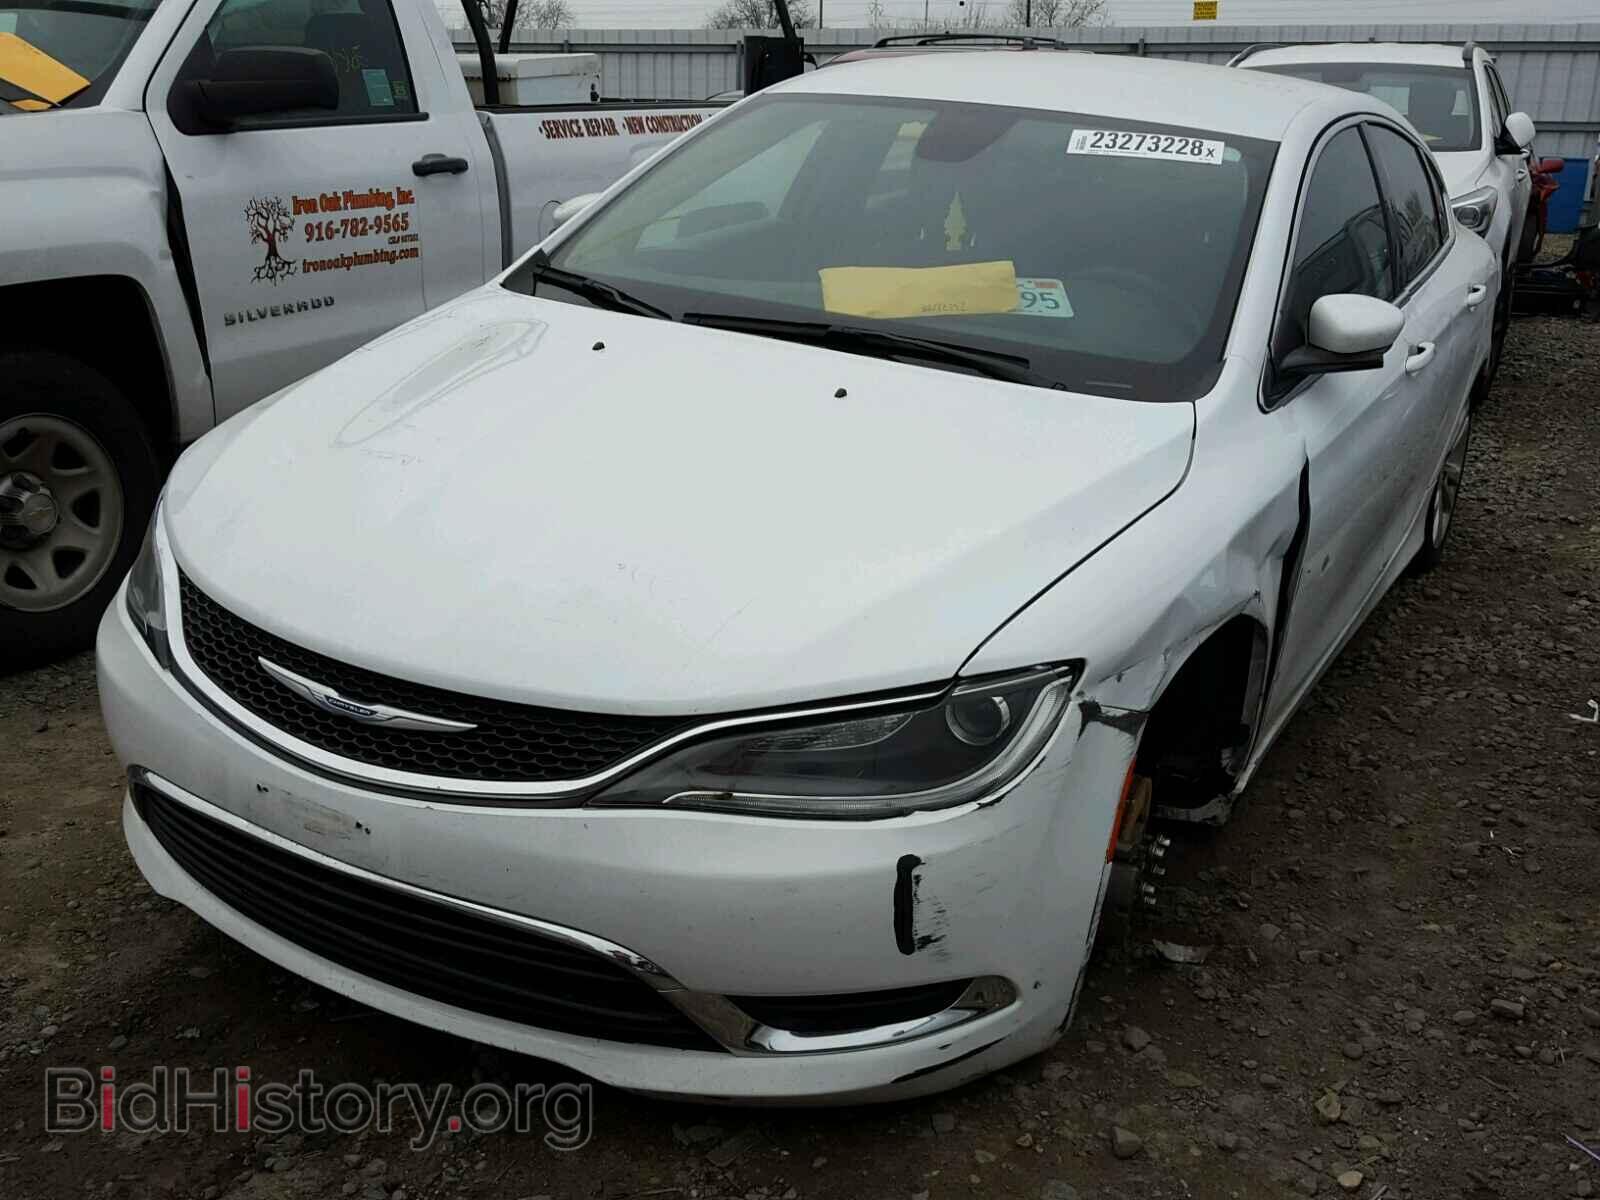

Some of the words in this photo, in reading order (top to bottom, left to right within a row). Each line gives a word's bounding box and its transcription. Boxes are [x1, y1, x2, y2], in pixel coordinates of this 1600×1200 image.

[541, 119, 584, 139] SERVICE
[582, 117, 619, 136] REPAIR
[624, 115, 646, 135] NEW
[1089, 131, 1204, 157] 23273228
[292, 195, 318, 216] Iron
[319, 191, 341, 212] Oak
[304, 211, 409, 243] 916-782-9565
[223, 296, 335, 326] SILVERADO
